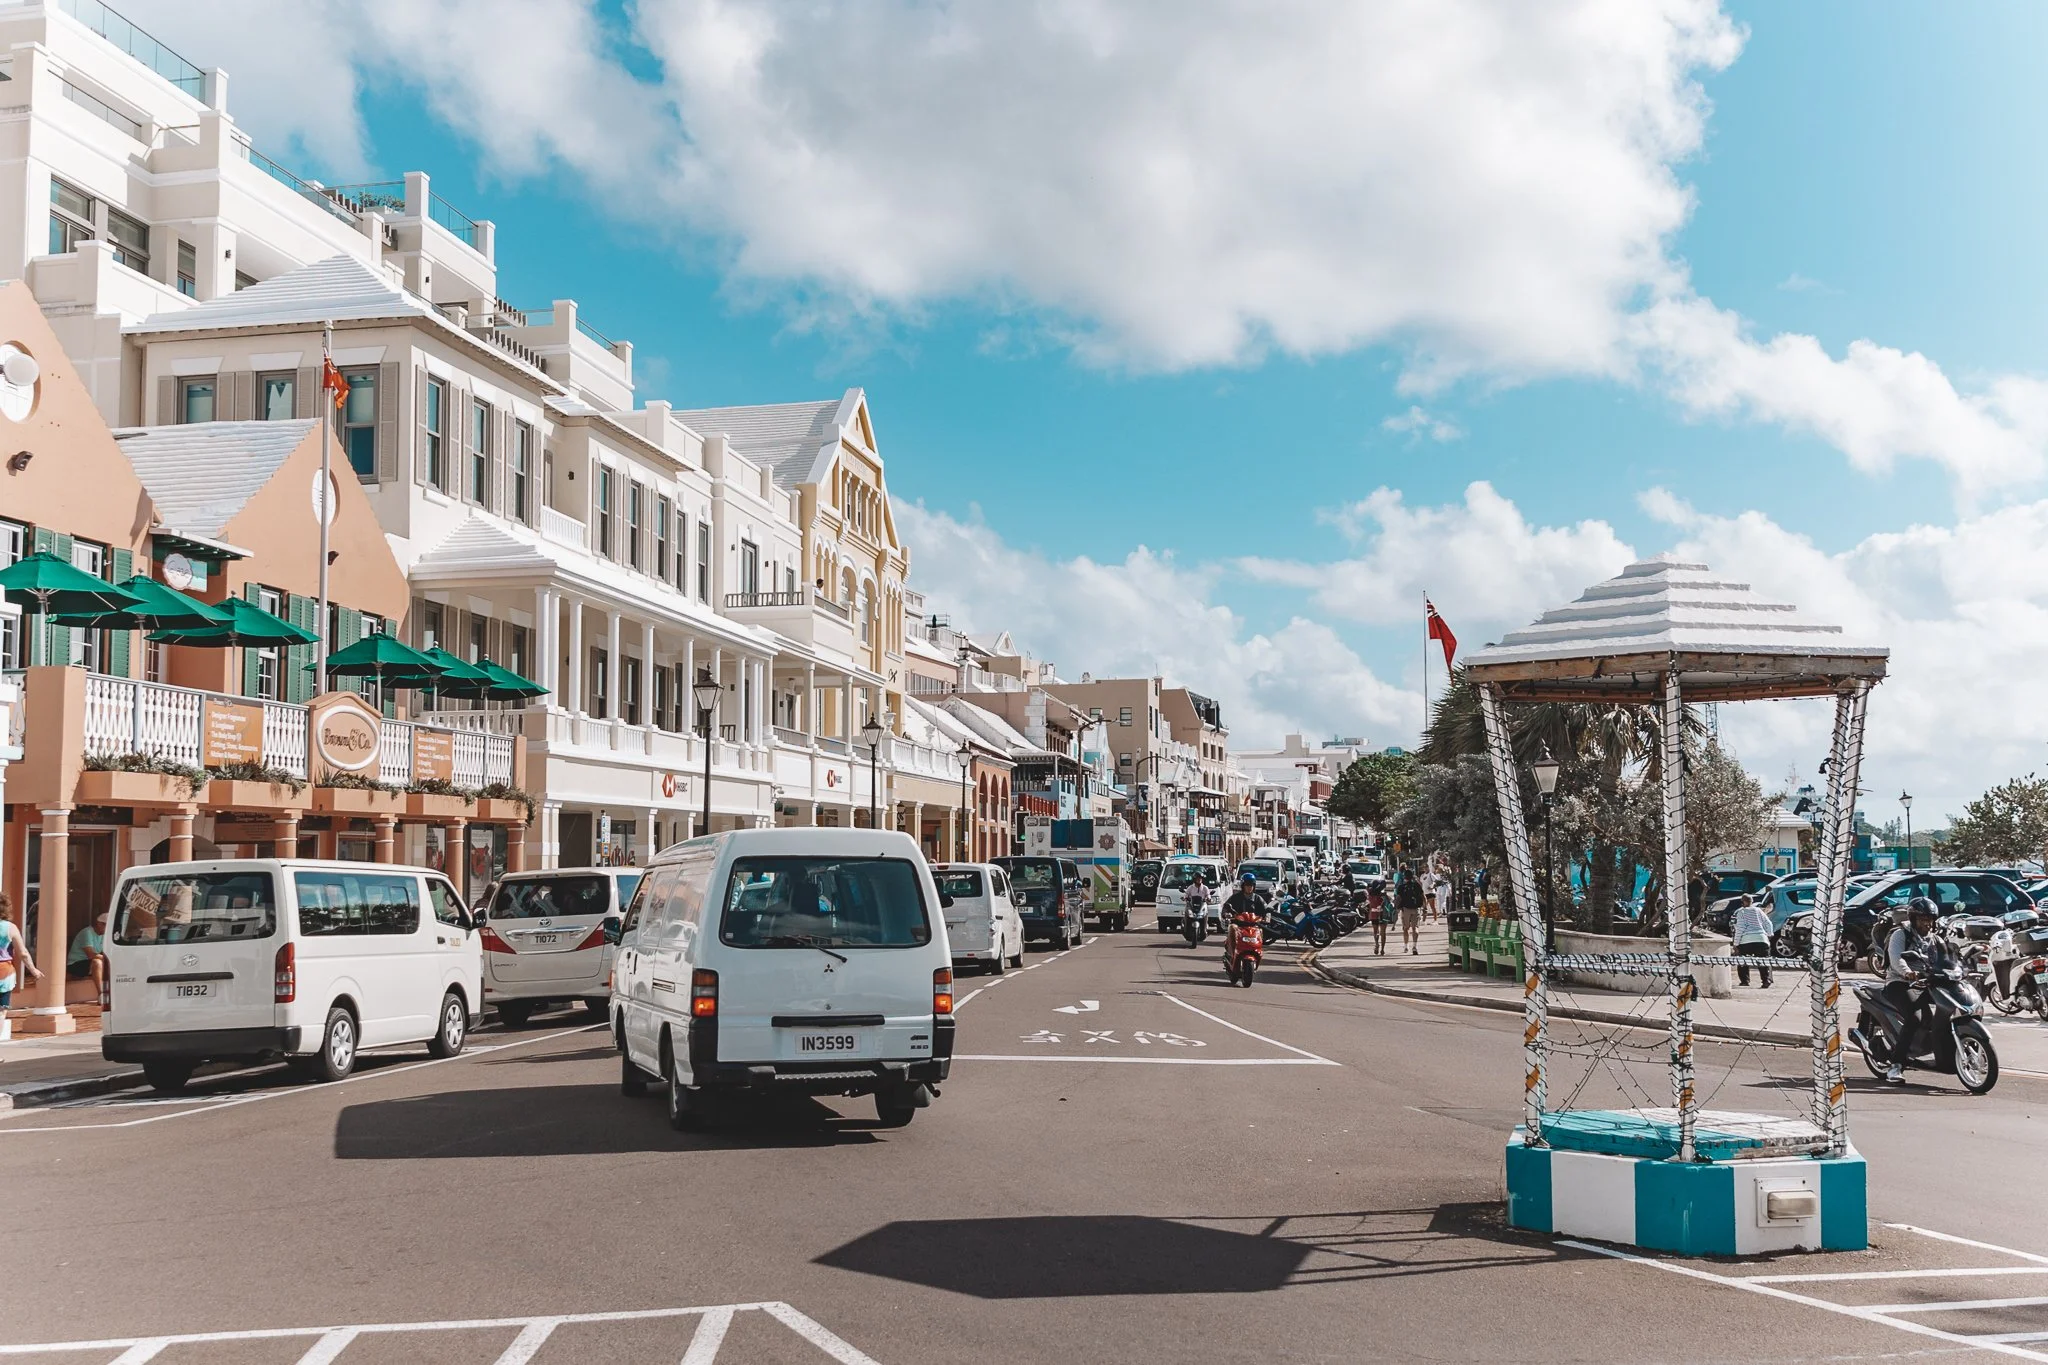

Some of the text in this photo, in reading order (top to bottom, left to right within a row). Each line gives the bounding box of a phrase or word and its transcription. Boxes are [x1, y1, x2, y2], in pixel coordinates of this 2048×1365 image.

[324, 728, 350, 746] Brown
[176, 985, 207, 996] T1832
[802, 1035, 854, 1051] IN3599
